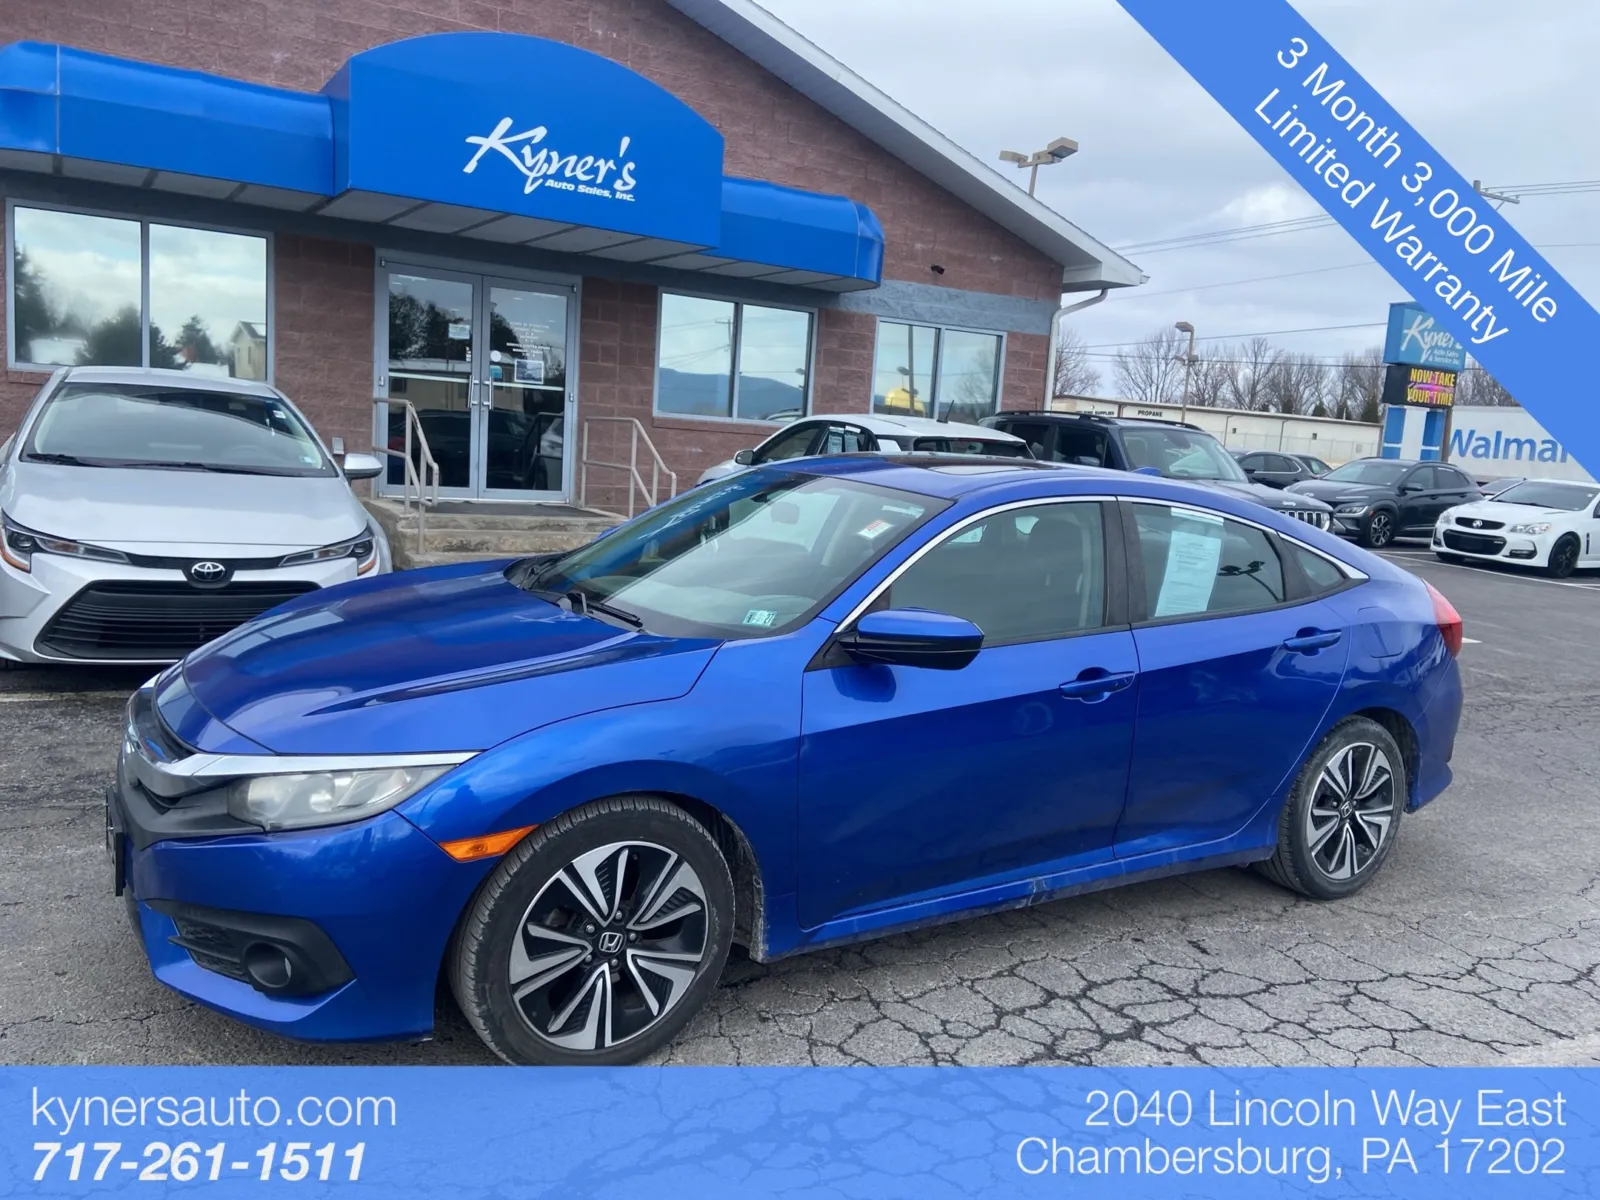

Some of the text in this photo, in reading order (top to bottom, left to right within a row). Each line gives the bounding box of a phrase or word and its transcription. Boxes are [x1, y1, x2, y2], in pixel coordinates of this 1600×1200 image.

[463, 116, 637, 195] Kyner's
[544, 179, 575, 191] Auto
[577, 184, 612, 199] Sales,
[1410, 368, 1456, 387] NOW TAKE
[1407, 388, 1454, 406] YOUR TIME
[1137, 409, 1163, 418] PROPANE
